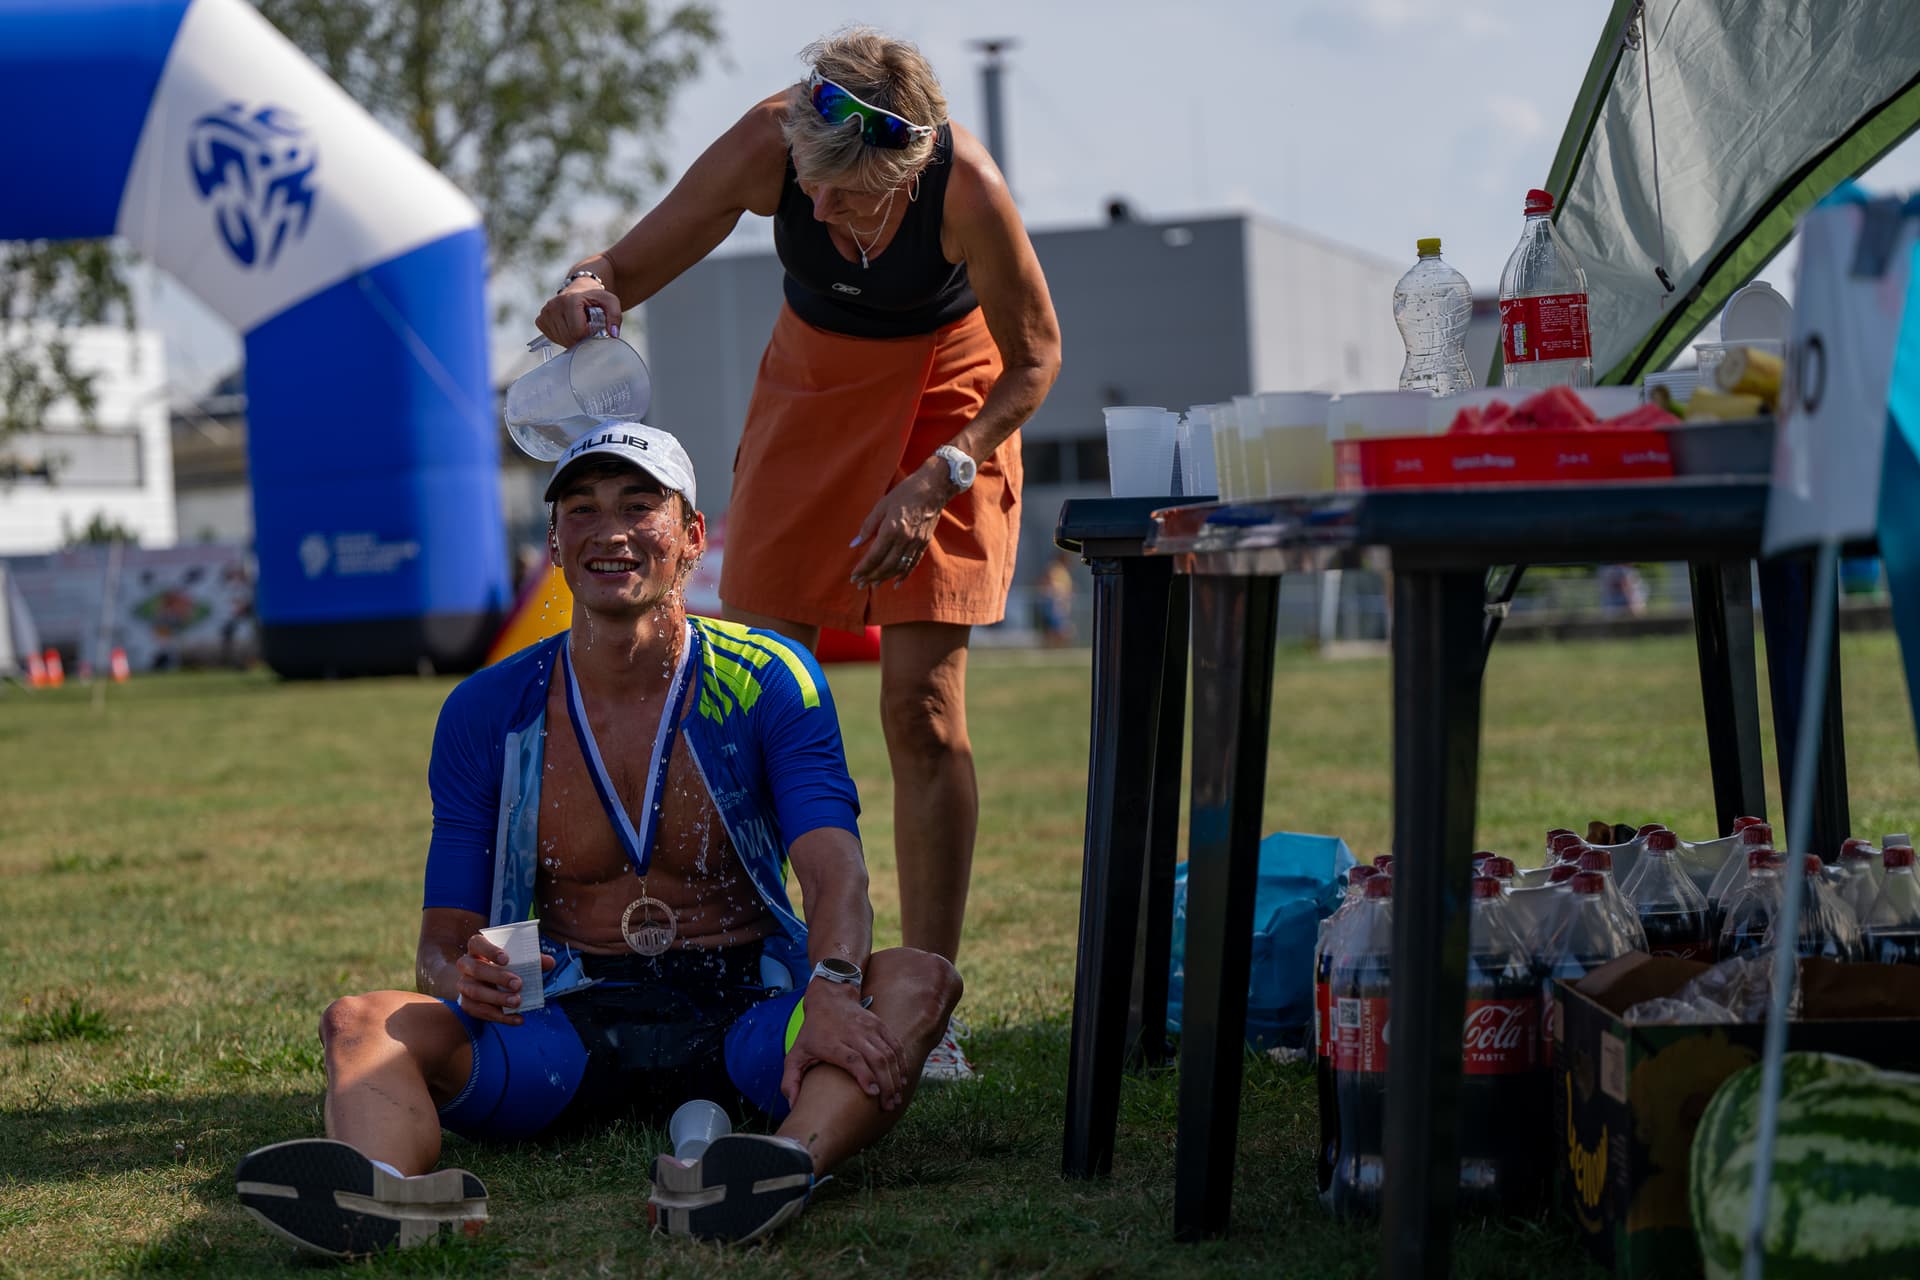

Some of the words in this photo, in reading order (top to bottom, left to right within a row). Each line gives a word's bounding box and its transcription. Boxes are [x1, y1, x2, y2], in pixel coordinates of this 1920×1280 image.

[570, 433, 649, 458] HUUB
[1463, 1004, 1527, 1050] Cola
[1471, 1052, 1506, 1062] TASTE
